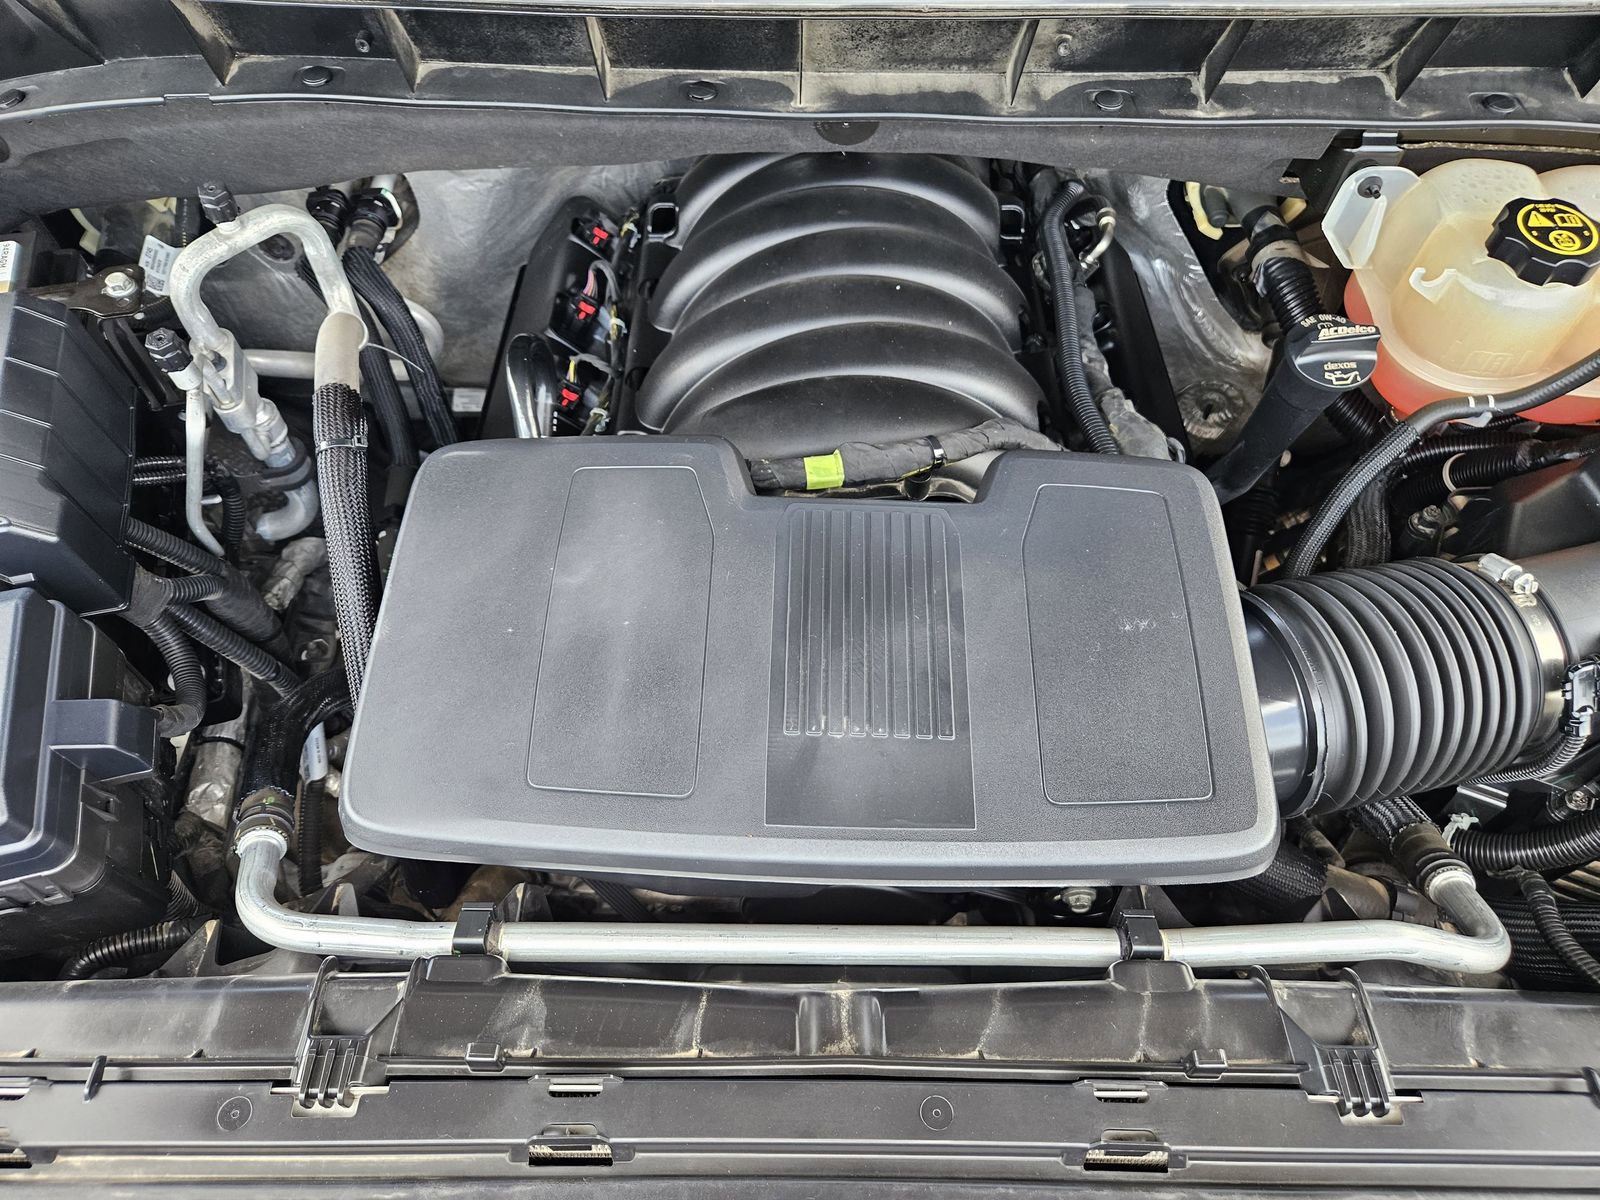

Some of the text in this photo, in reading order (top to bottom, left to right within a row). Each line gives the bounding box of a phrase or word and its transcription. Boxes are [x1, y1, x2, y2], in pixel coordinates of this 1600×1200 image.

[1301, 316, 1317, 328] SAE
[1318, 325, 1376, 338] ACDelco
[1324, 362, 1357, 371] dexos
